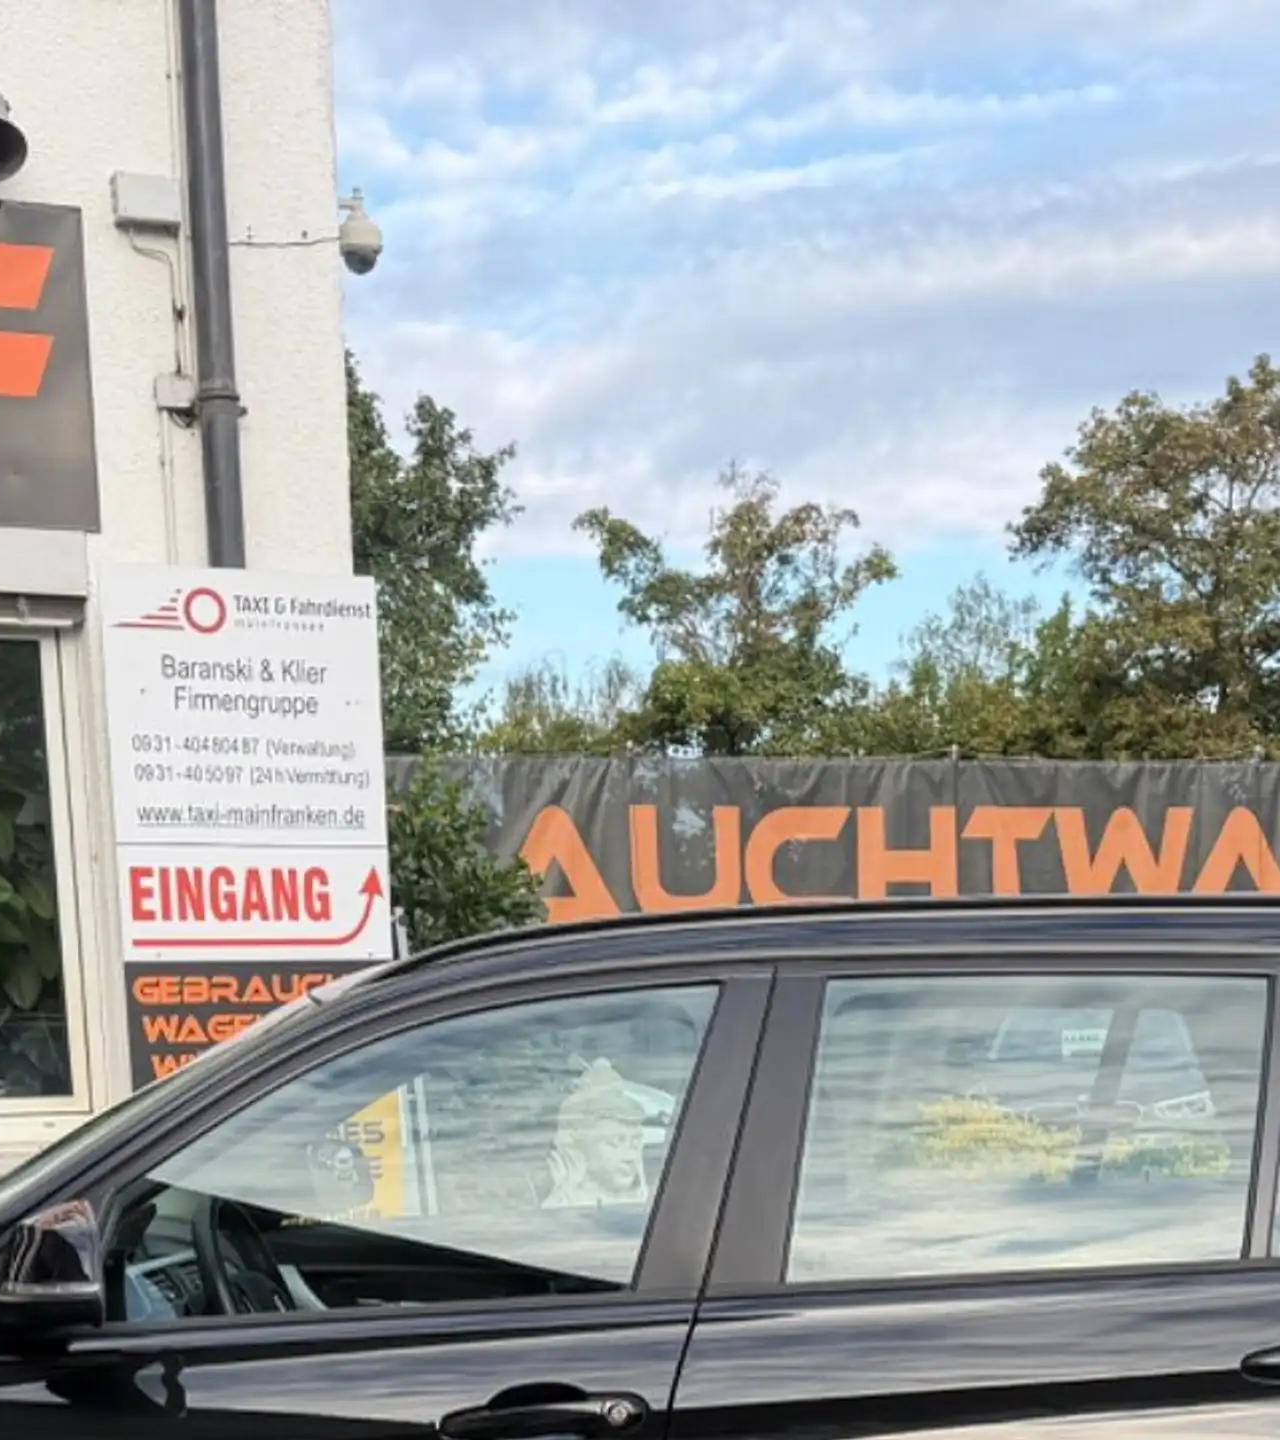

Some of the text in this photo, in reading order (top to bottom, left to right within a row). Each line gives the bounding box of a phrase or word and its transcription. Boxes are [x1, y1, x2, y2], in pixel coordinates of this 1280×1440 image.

[233, 594, 269, 615] TAXI
[290, 598, 371, 619] Fahrdienst
[161, 654, 328, 684] Baranski & Klier
[173, 685, 319, 719] Firmengruppe
[137, 802, 366, 827] www.taxi-mainfranken.de
[128, 865, 331, 922] EINGANG
[142, 1013, 261, 1043] WAGE
